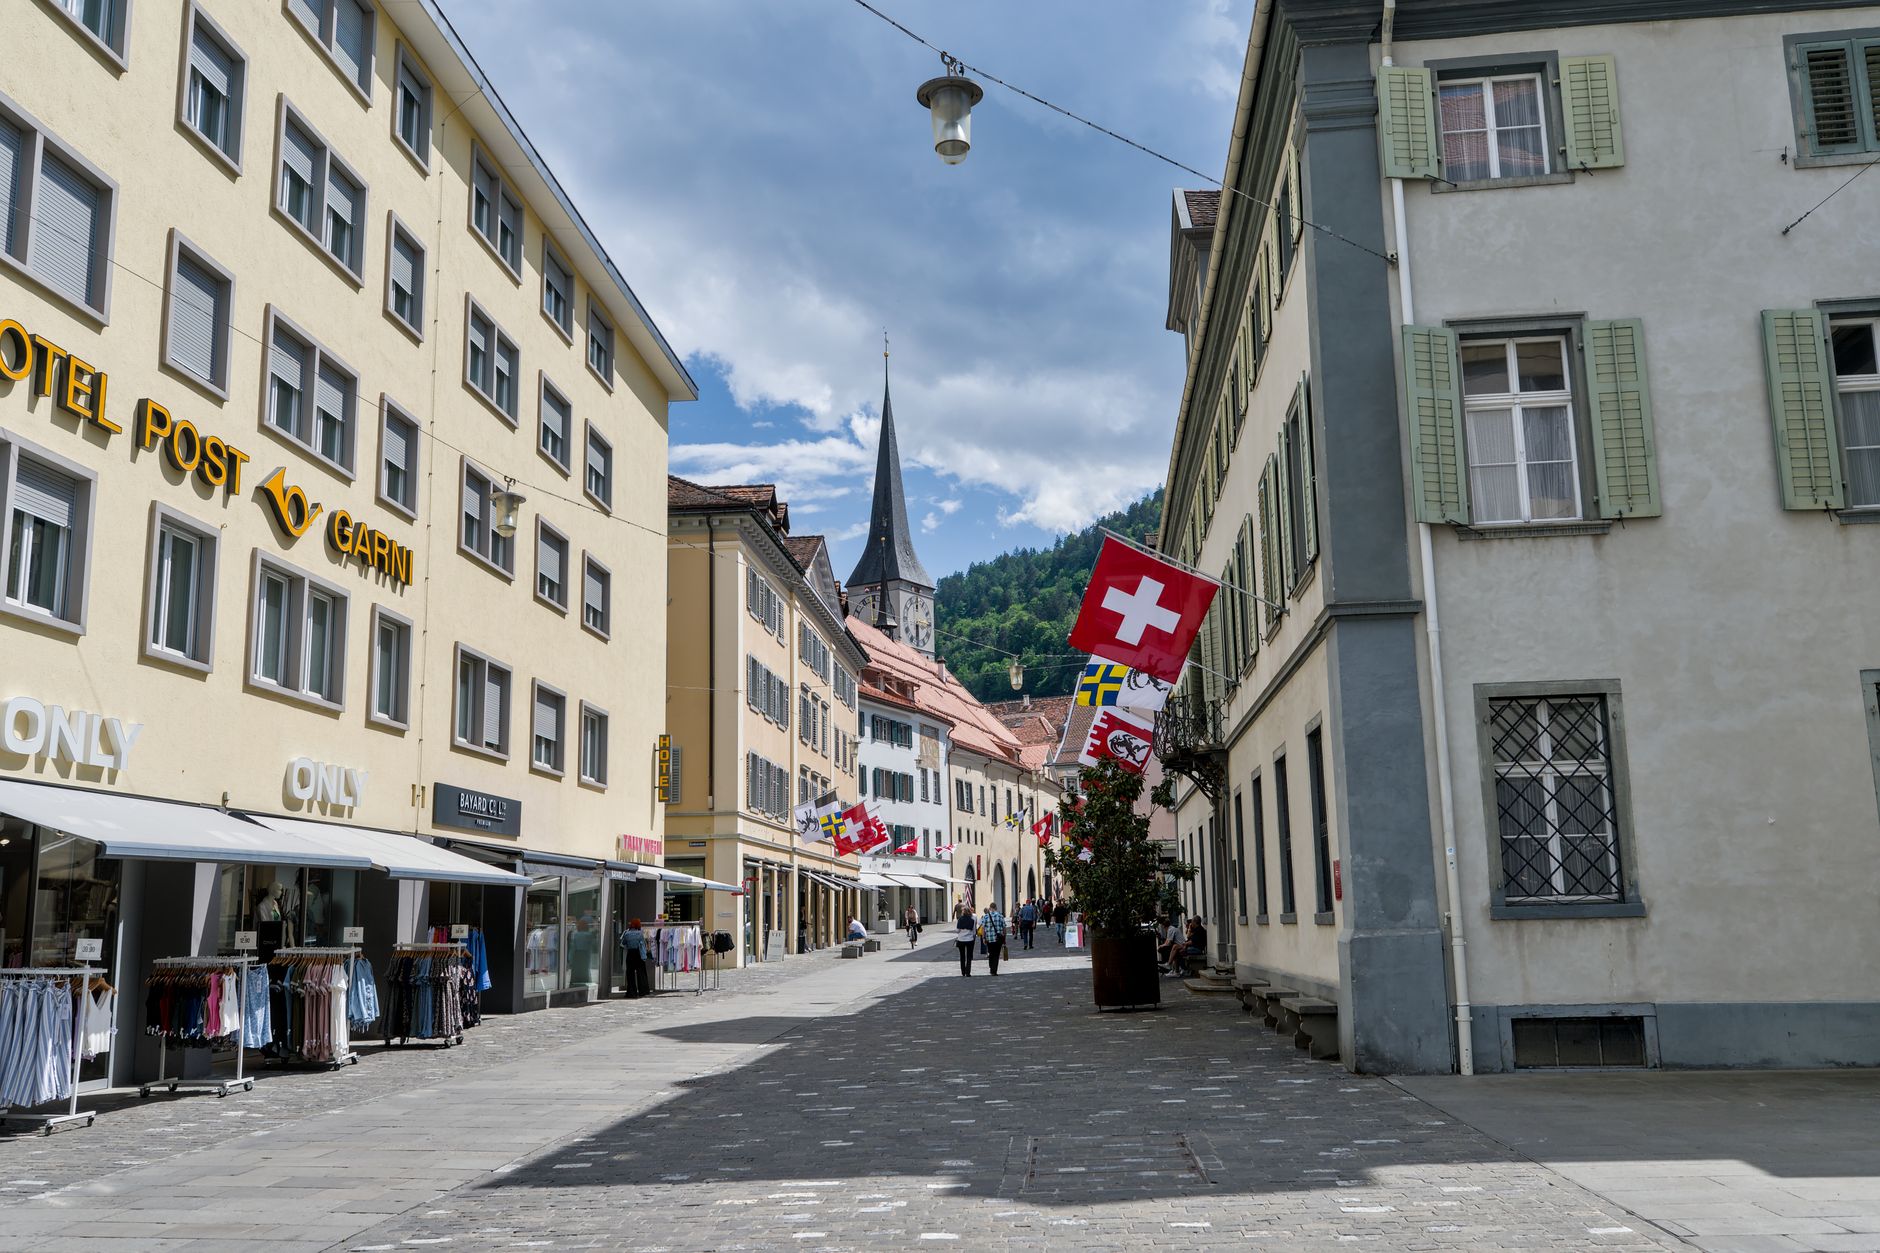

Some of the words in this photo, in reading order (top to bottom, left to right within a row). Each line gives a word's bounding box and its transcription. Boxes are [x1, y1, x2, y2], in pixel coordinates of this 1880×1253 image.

[138, 398, 250, 495] POST
[328, 510, 413, 586] GARNI
[4, 696, 144, 770] ONLY
[289, 757, 369, 808] ONLY
[659, 736, 670, 800] HOTEL
[460, 793, 487, 811] BAYARD
[623, 834, 643, 852] TALLY
